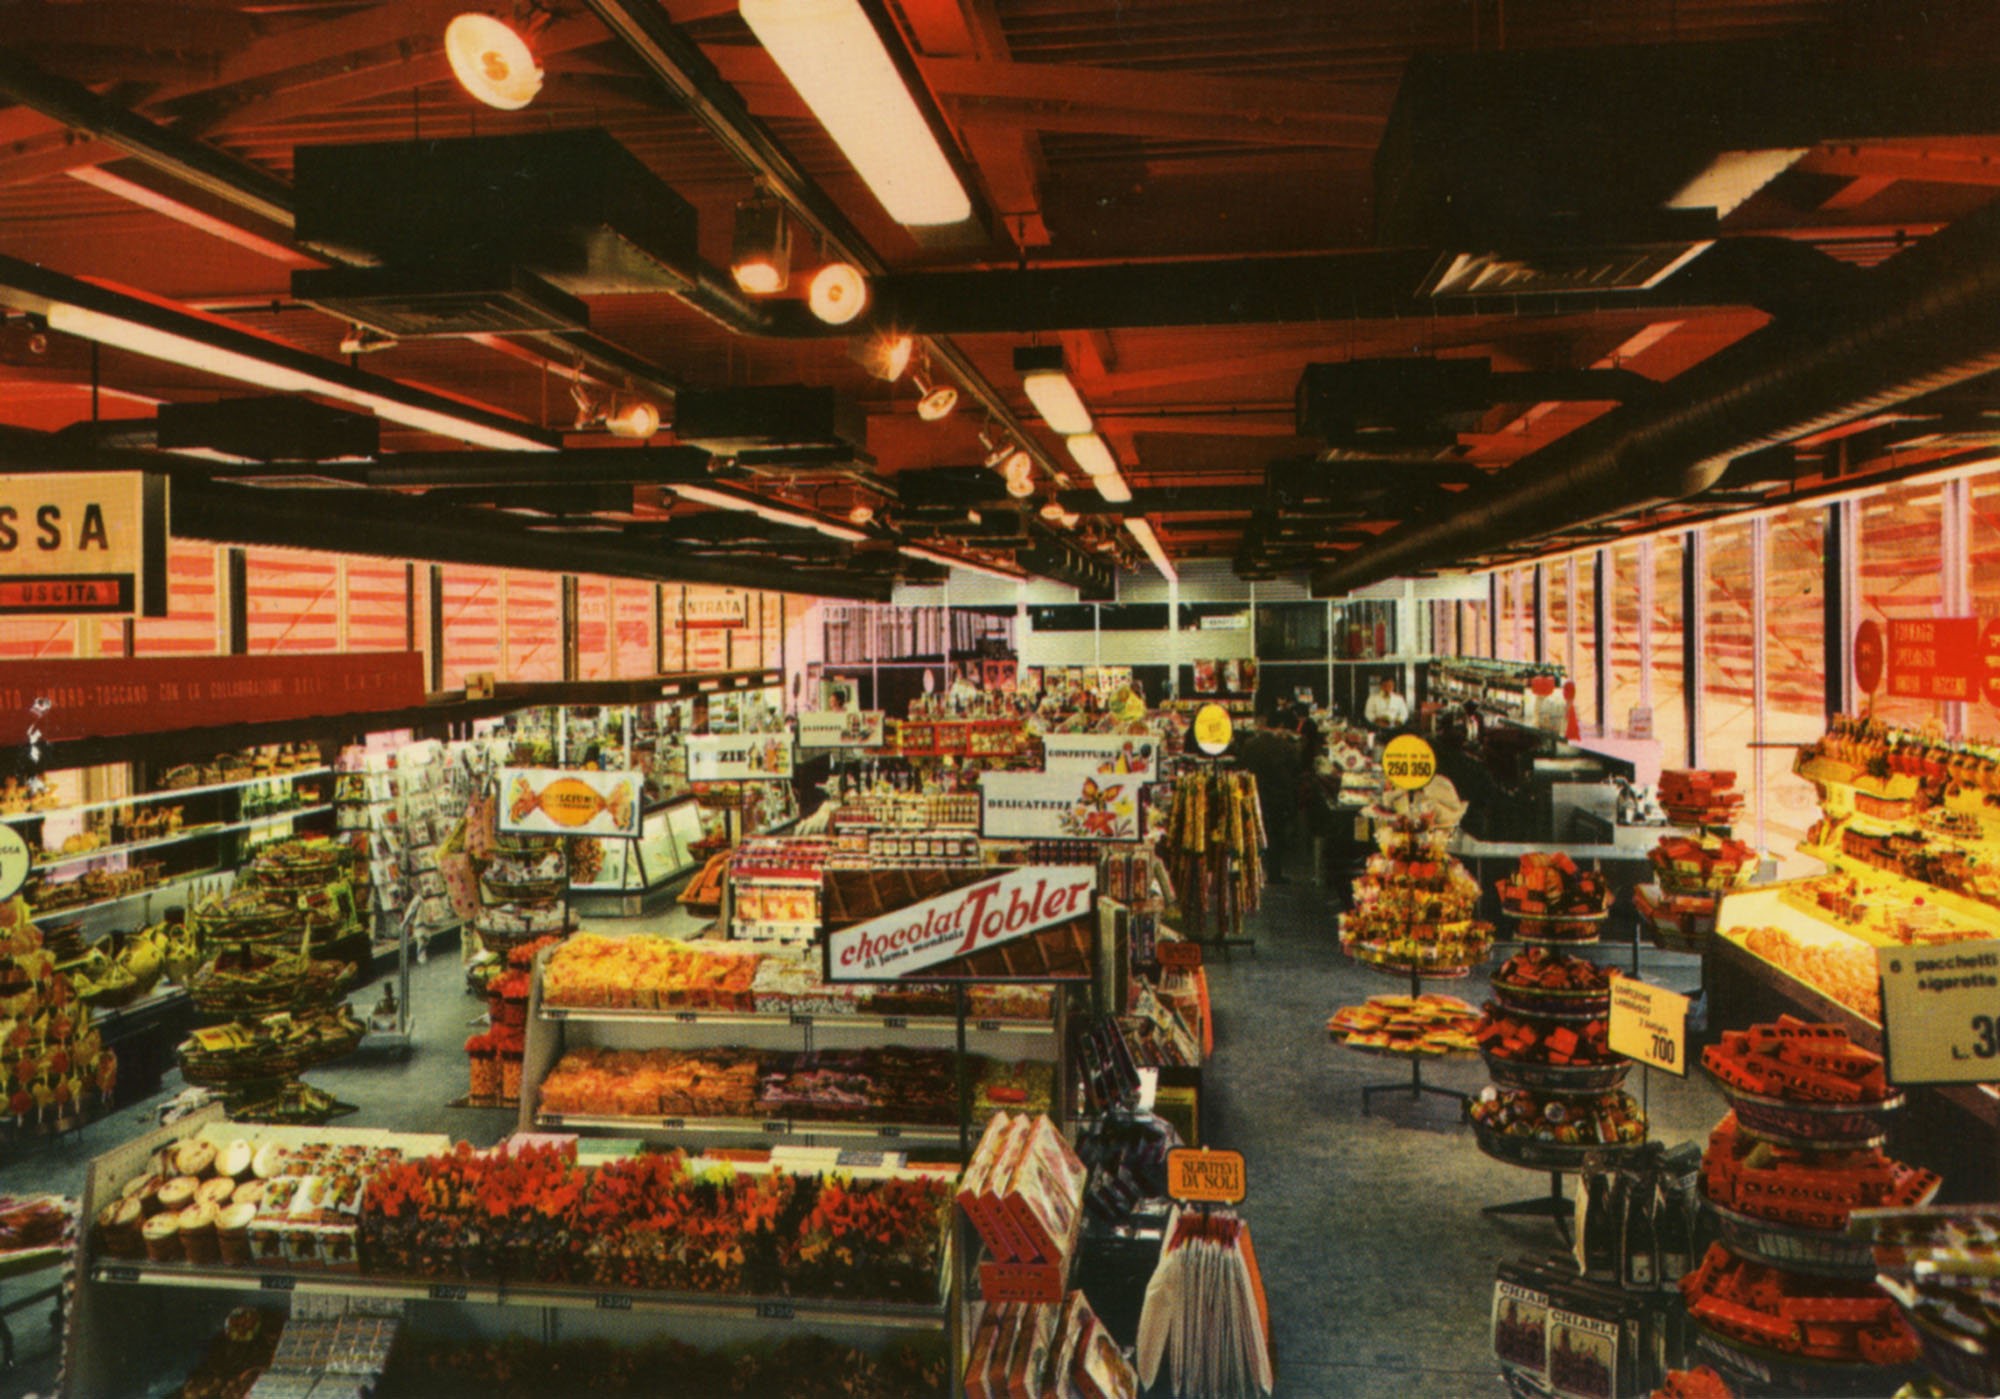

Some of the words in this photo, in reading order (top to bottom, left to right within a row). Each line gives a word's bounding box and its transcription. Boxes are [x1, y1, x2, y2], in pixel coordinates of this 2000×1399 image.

[0, 503, 109, 551] SSA
[21, 584, 98, 602] USCITA
[839, 908, 968, 967] chocolat
[953, 879, 1091, 955] Tobler
[1914, 952, 1998, 974] pacchetti
[1917, 973, 1998, 994] sigarette
[1651, 1032, 1676, 1065] 700
[1971, 1013, 2000, 1059] 3
[1182, 1175, 1199, 1189] DA
[1551, 1310, 1617, 1335] CHIARLI
